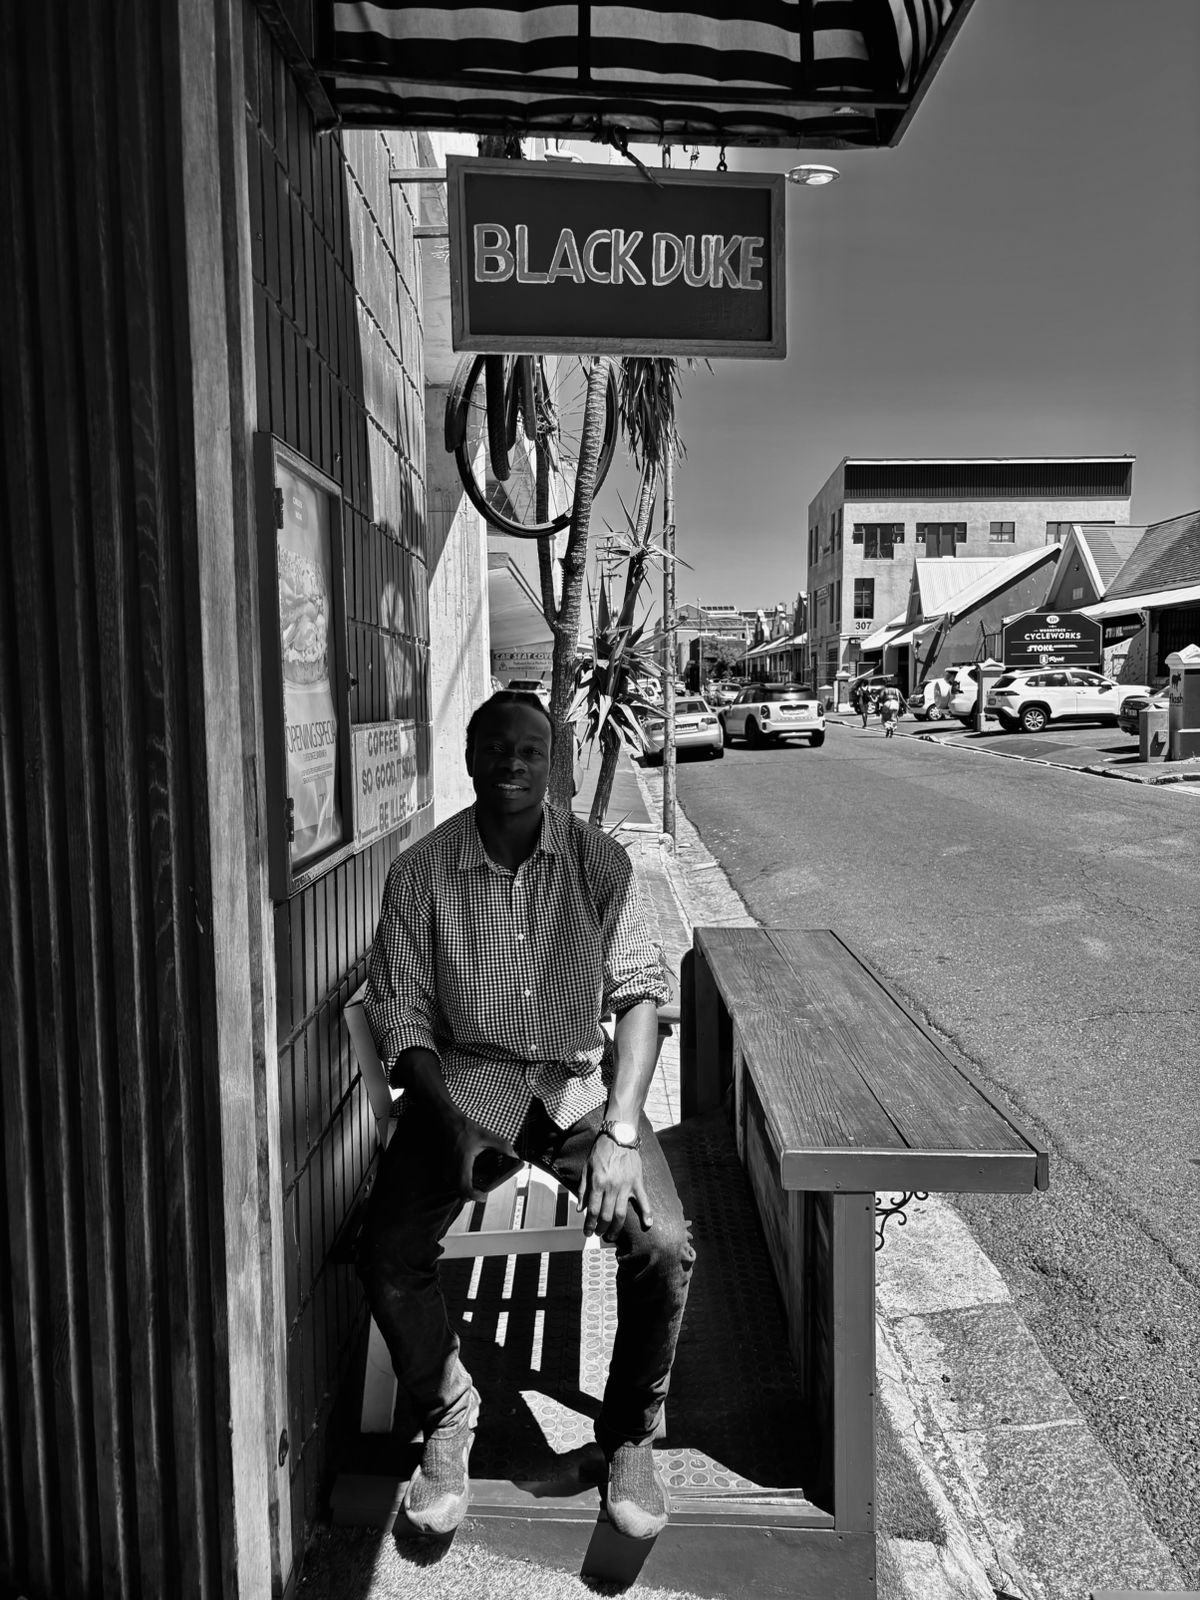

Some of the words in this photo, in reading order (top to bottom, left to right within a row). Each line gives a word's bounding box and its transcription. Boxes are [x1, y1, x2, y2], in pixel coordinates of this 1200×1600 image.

[473, 223, 647, 286] BLACK
[652, 232, 765, 290] DUKE
[855, 621, 871, 630] 307
[1024, 632, 1081, 640] CYCLEWORKS
[1026, 644, 1055, 652] STOKE
[285, 723, 318, 753] OPENING
[367, 730, 399, 757] COFFEE
[362, 767, 373, 796] SO
[380, 801, 390, 833] BE
